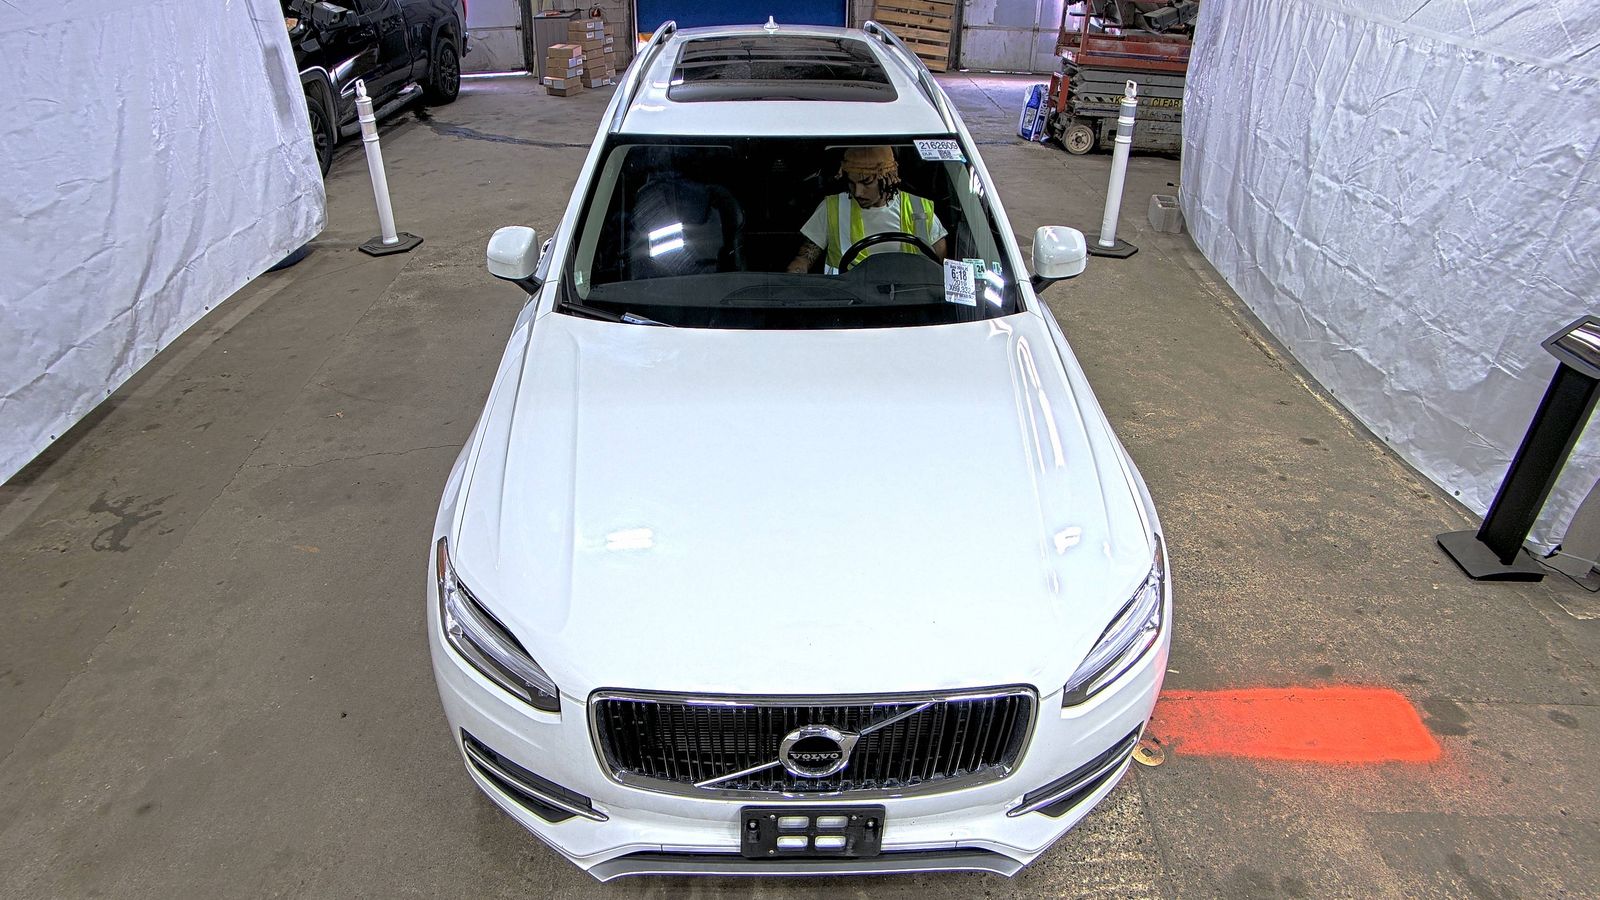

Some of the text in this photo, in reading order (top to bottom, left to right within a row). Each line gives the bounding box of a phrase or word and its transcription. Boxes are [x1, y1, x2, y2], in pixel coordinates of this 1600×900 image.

[1151, 98, 1180, 108] CLEAR
[976, 265, 985, 273] 24
[951, 269, 968, 281] 6:18
[790, 752, 839, 760] VOLVO
